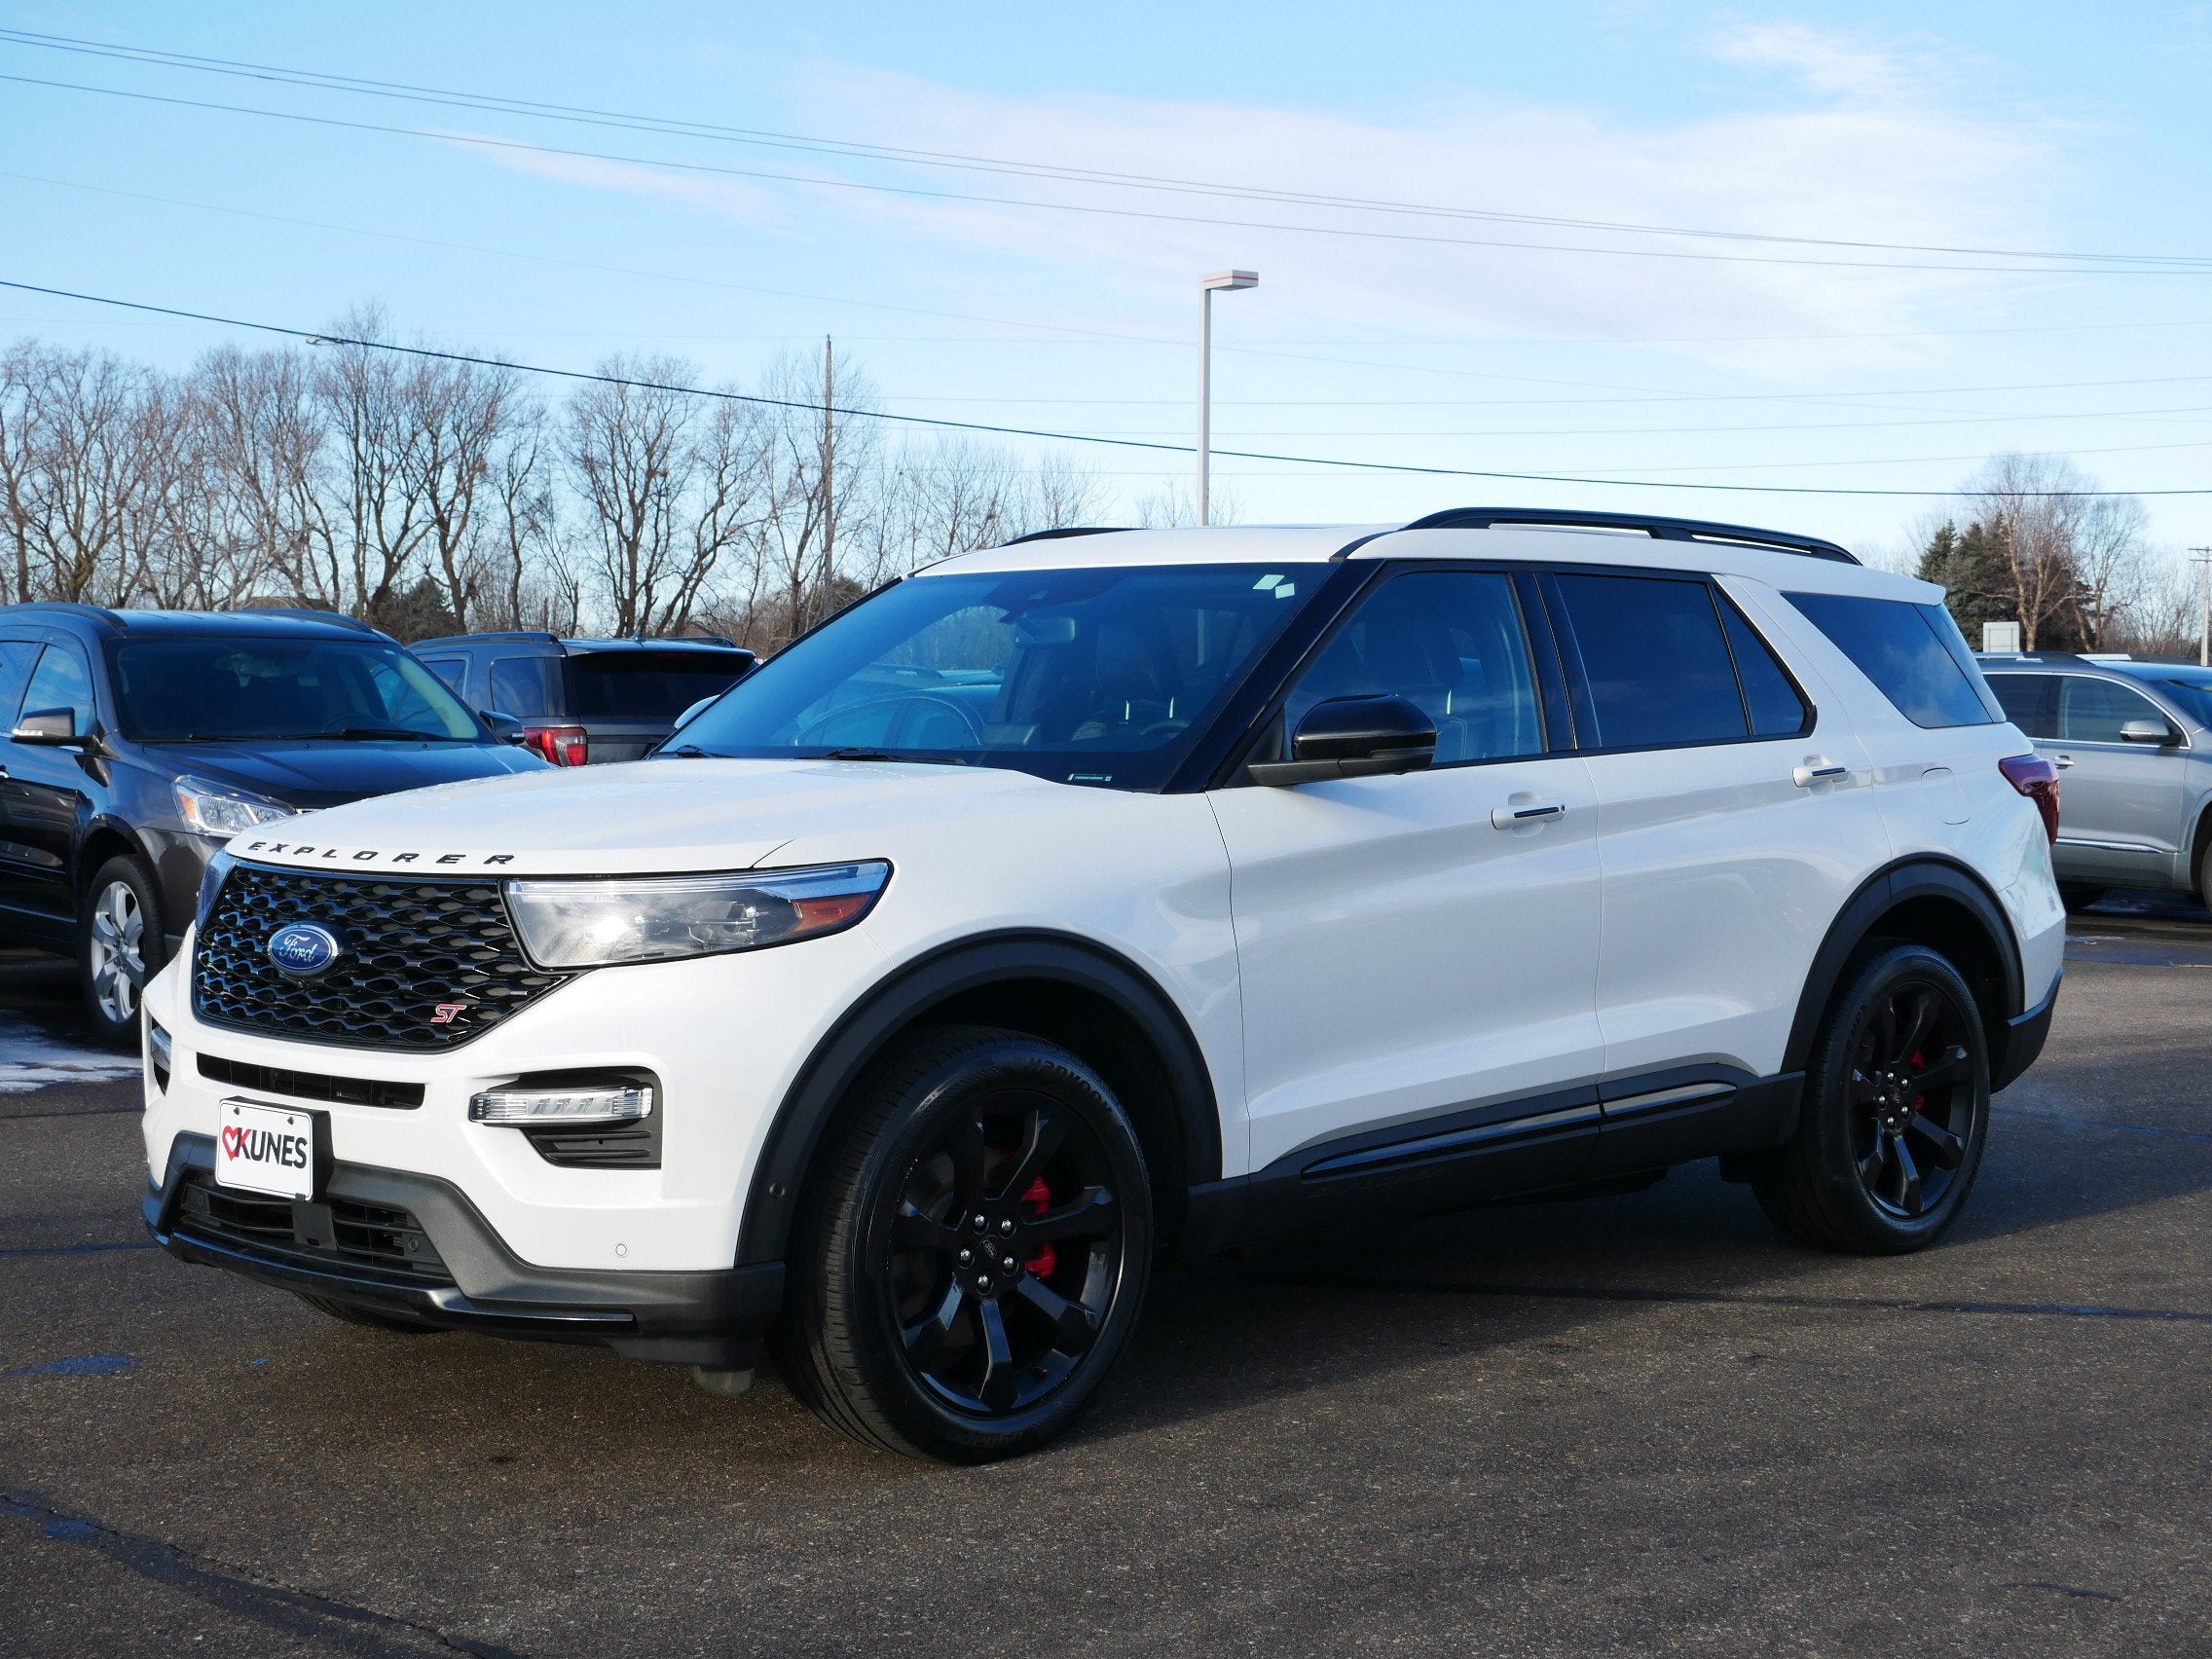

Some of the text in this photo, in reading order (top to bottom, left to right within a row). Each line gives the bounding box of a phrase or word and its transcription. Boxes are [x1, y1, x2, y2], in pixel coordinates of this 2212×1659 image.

[247, 840, 516, 866] EXPLORER
[278, 933, 319, 963] Ford
[429, 1003, 467, 1023] ST
[234, 1126, 308, 1169] KUNES
